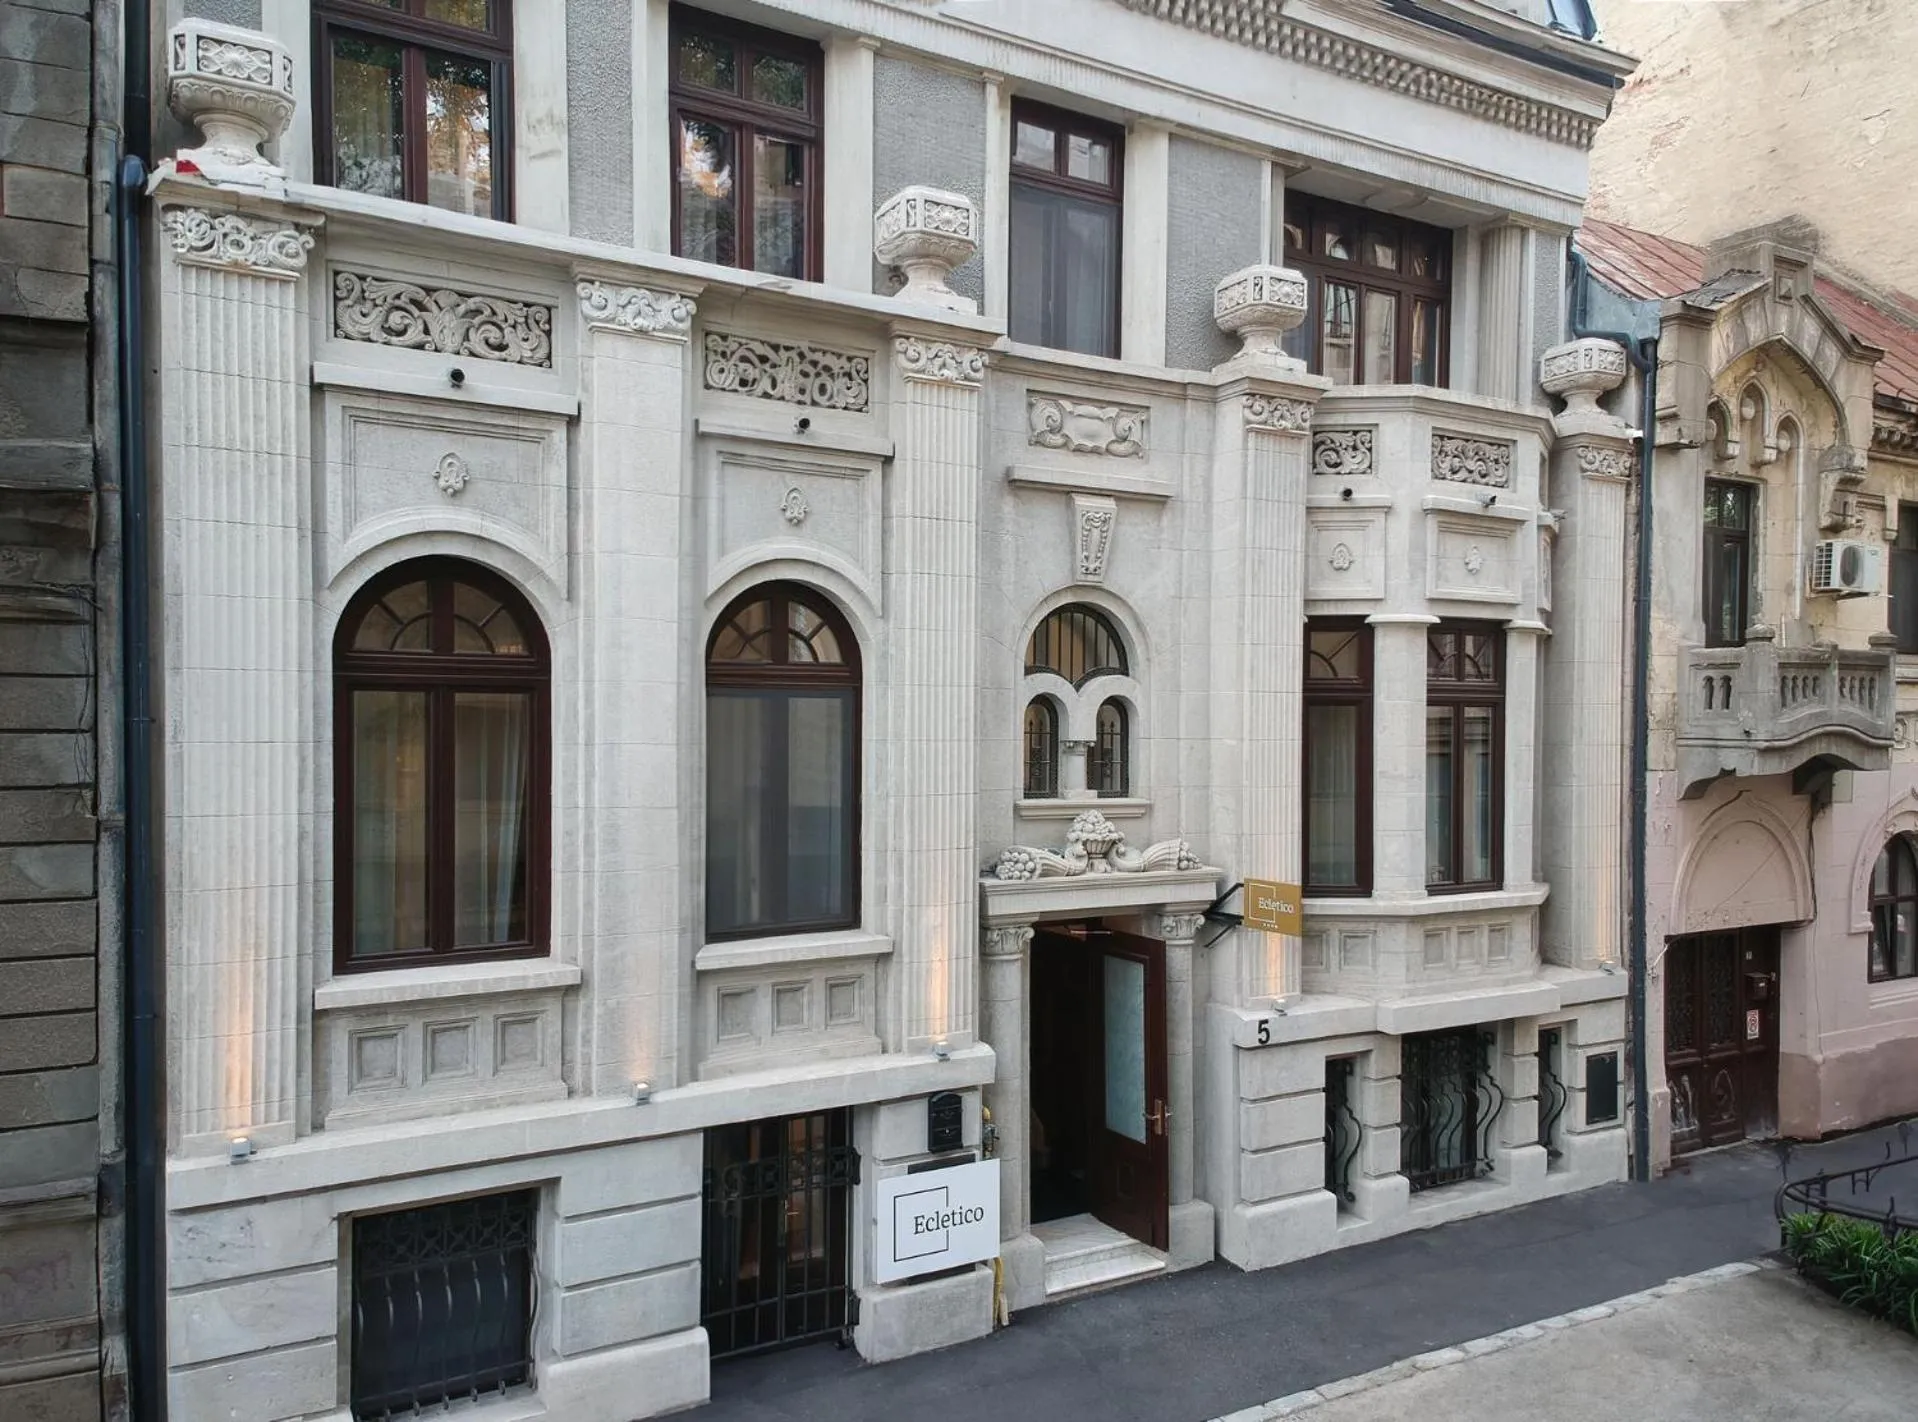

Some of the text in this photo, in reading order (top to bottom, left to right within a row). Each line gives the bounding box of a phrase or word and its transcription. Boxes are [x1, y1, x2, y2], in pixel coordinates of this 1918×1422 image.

[1258, 897, 1294, 914] Ecletico
[1258, 1019, 1270, 1044] 5
[914, 1206, 984, 1235] Ecletico
